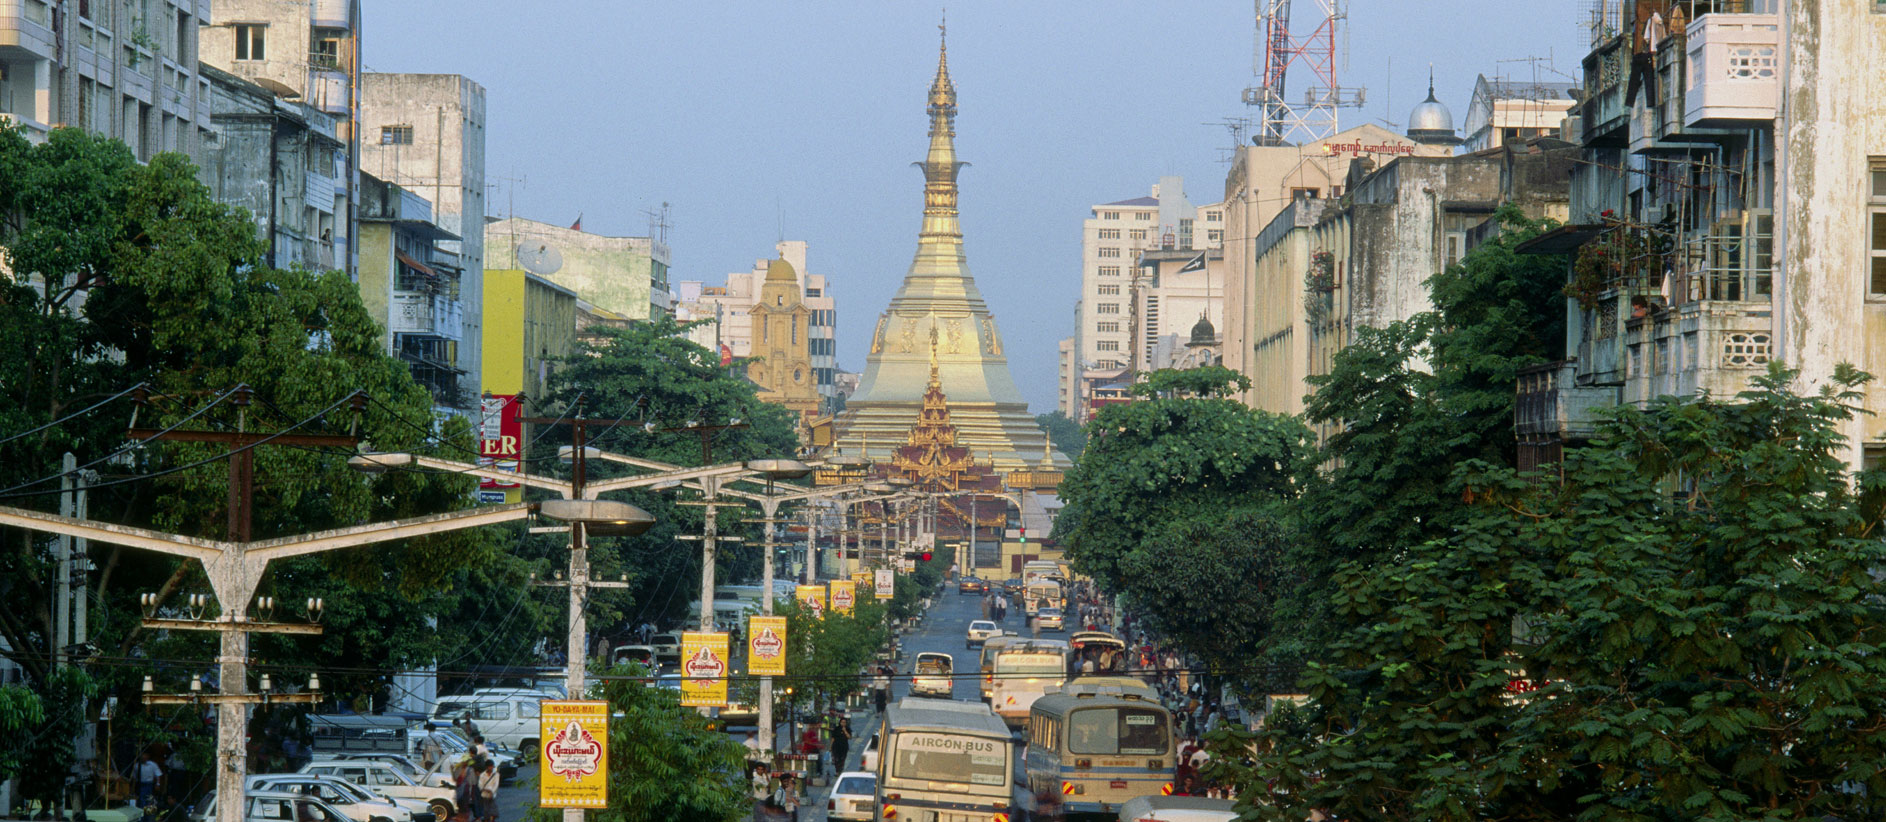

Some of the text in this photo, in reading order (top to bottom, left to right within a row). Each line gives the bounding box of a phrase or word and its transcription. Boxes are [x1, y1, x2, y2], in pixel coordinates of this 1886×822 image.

[481, 435, 517, 455] ER
[912, 737, 994, 752] AIRCON BUS
